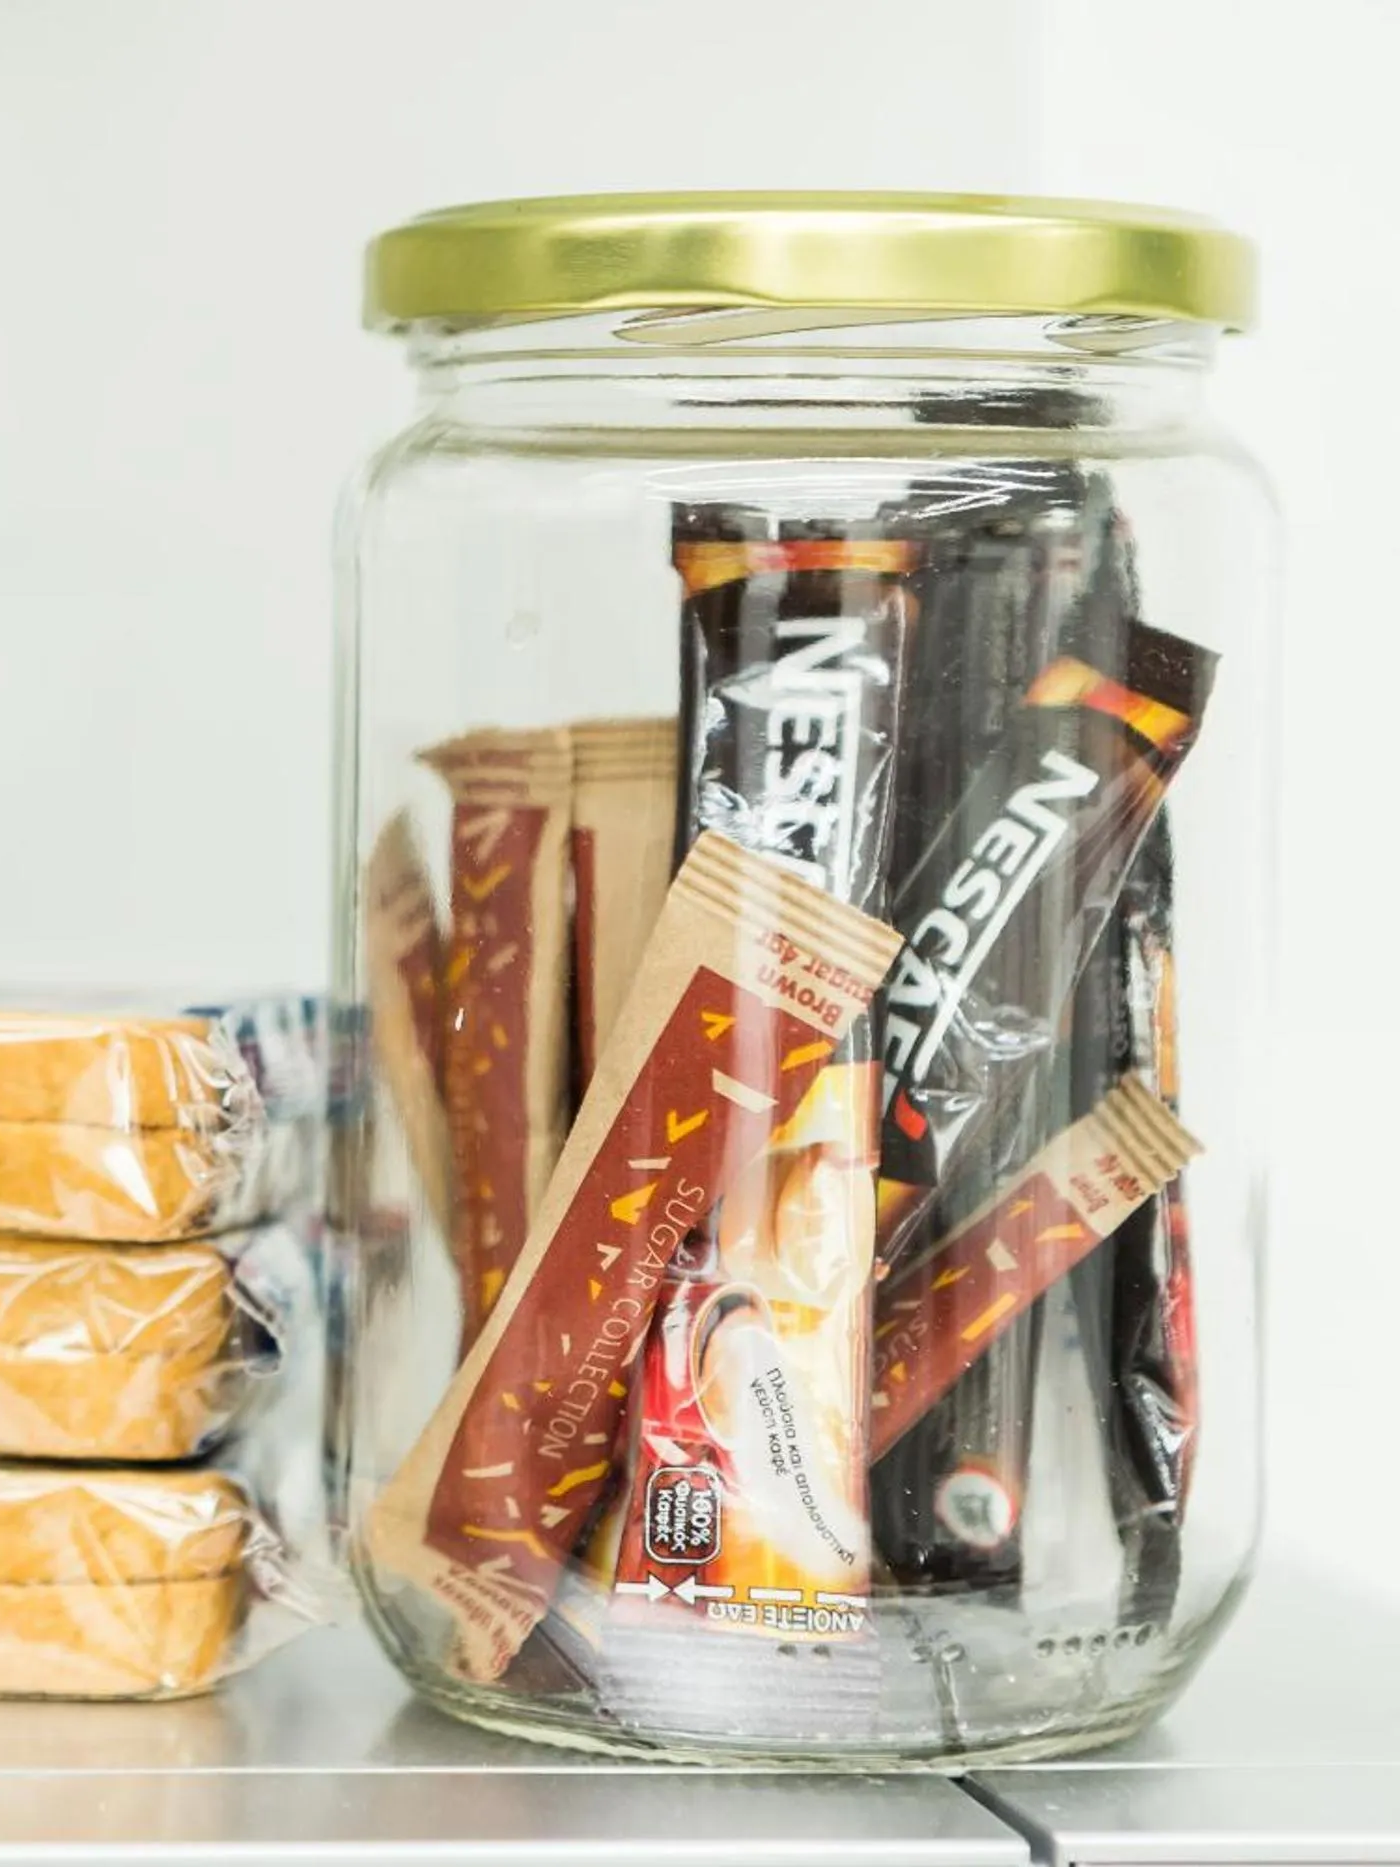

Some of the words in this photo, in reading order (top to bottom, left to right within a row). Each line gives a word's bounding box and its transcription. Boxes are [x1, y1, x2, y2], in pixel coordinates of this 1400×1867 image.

[757, 964, 844, 1027] Brown
[801, 955, 875, 1004] sugar
[626, 1177, 705, 1291] SUGAR
[538, 1298, 642, 1459] COLLECTION
[768, 1433, 789, 1476] καφέ
[788, 1444, 803, 1469] και
[655, 1489, 673, 1543] Καφές
[672, 1480, 692, 1553] Φυσικός
[690, 1488, 714, 1547] 100%
[708, 1602, 757, 1624] ΕΔΩ
